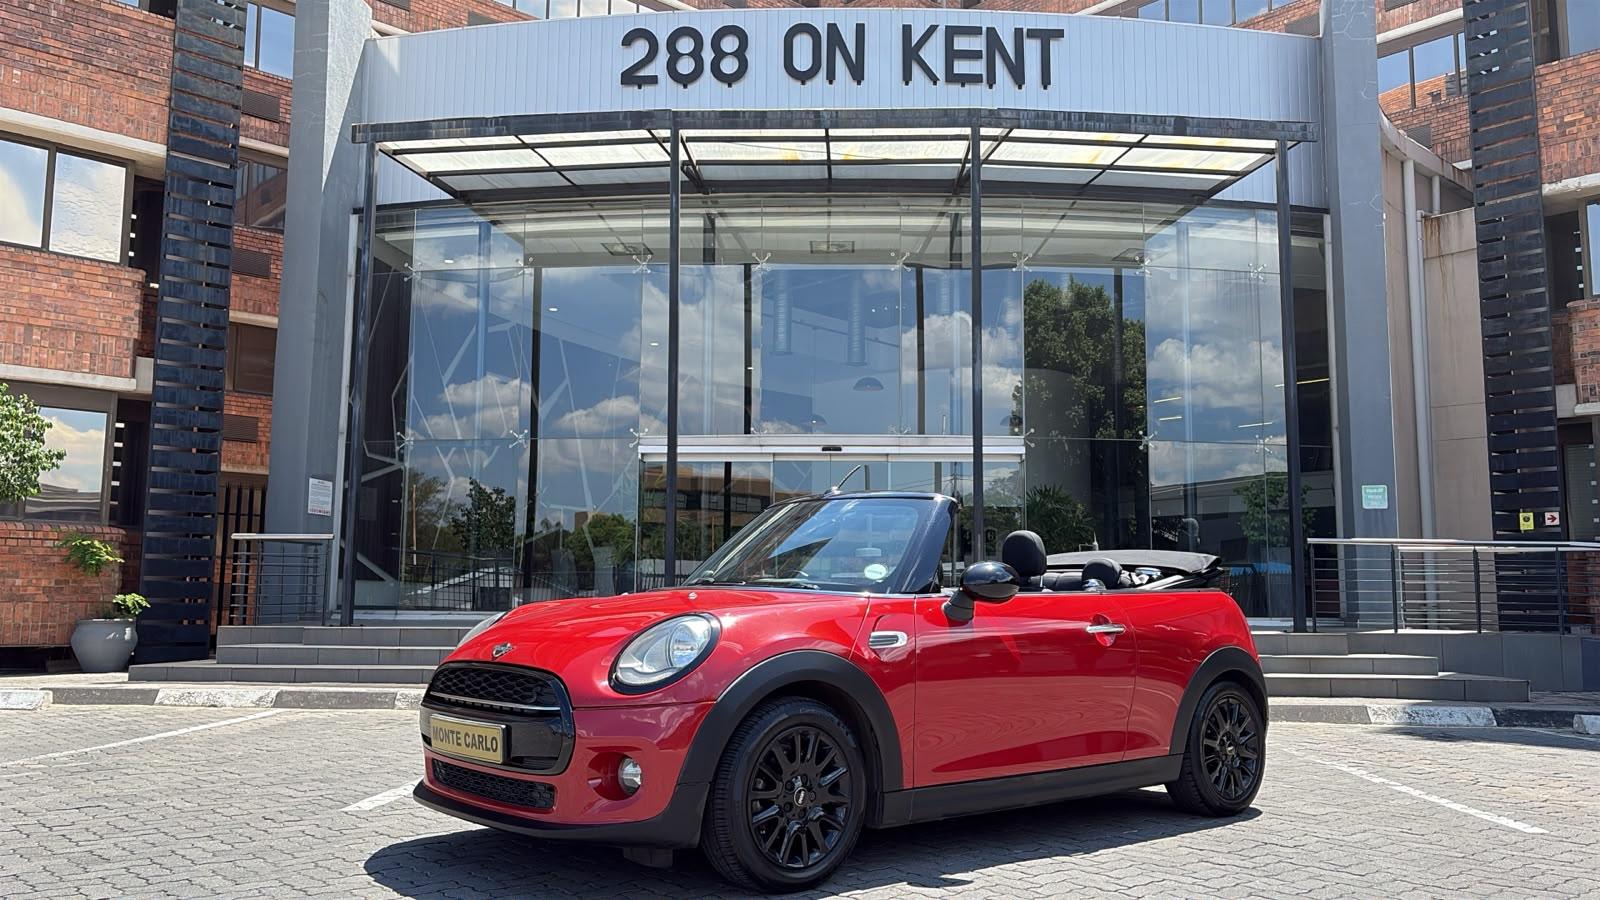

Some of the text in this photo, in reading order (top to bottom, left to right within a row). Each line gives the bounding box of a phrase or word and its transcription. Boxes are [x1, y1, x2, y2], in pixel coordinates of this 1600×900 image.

[621, 23, 1065, 88] 288 ON KENT
[432, 725, 498, 753] MONTE CARLO
